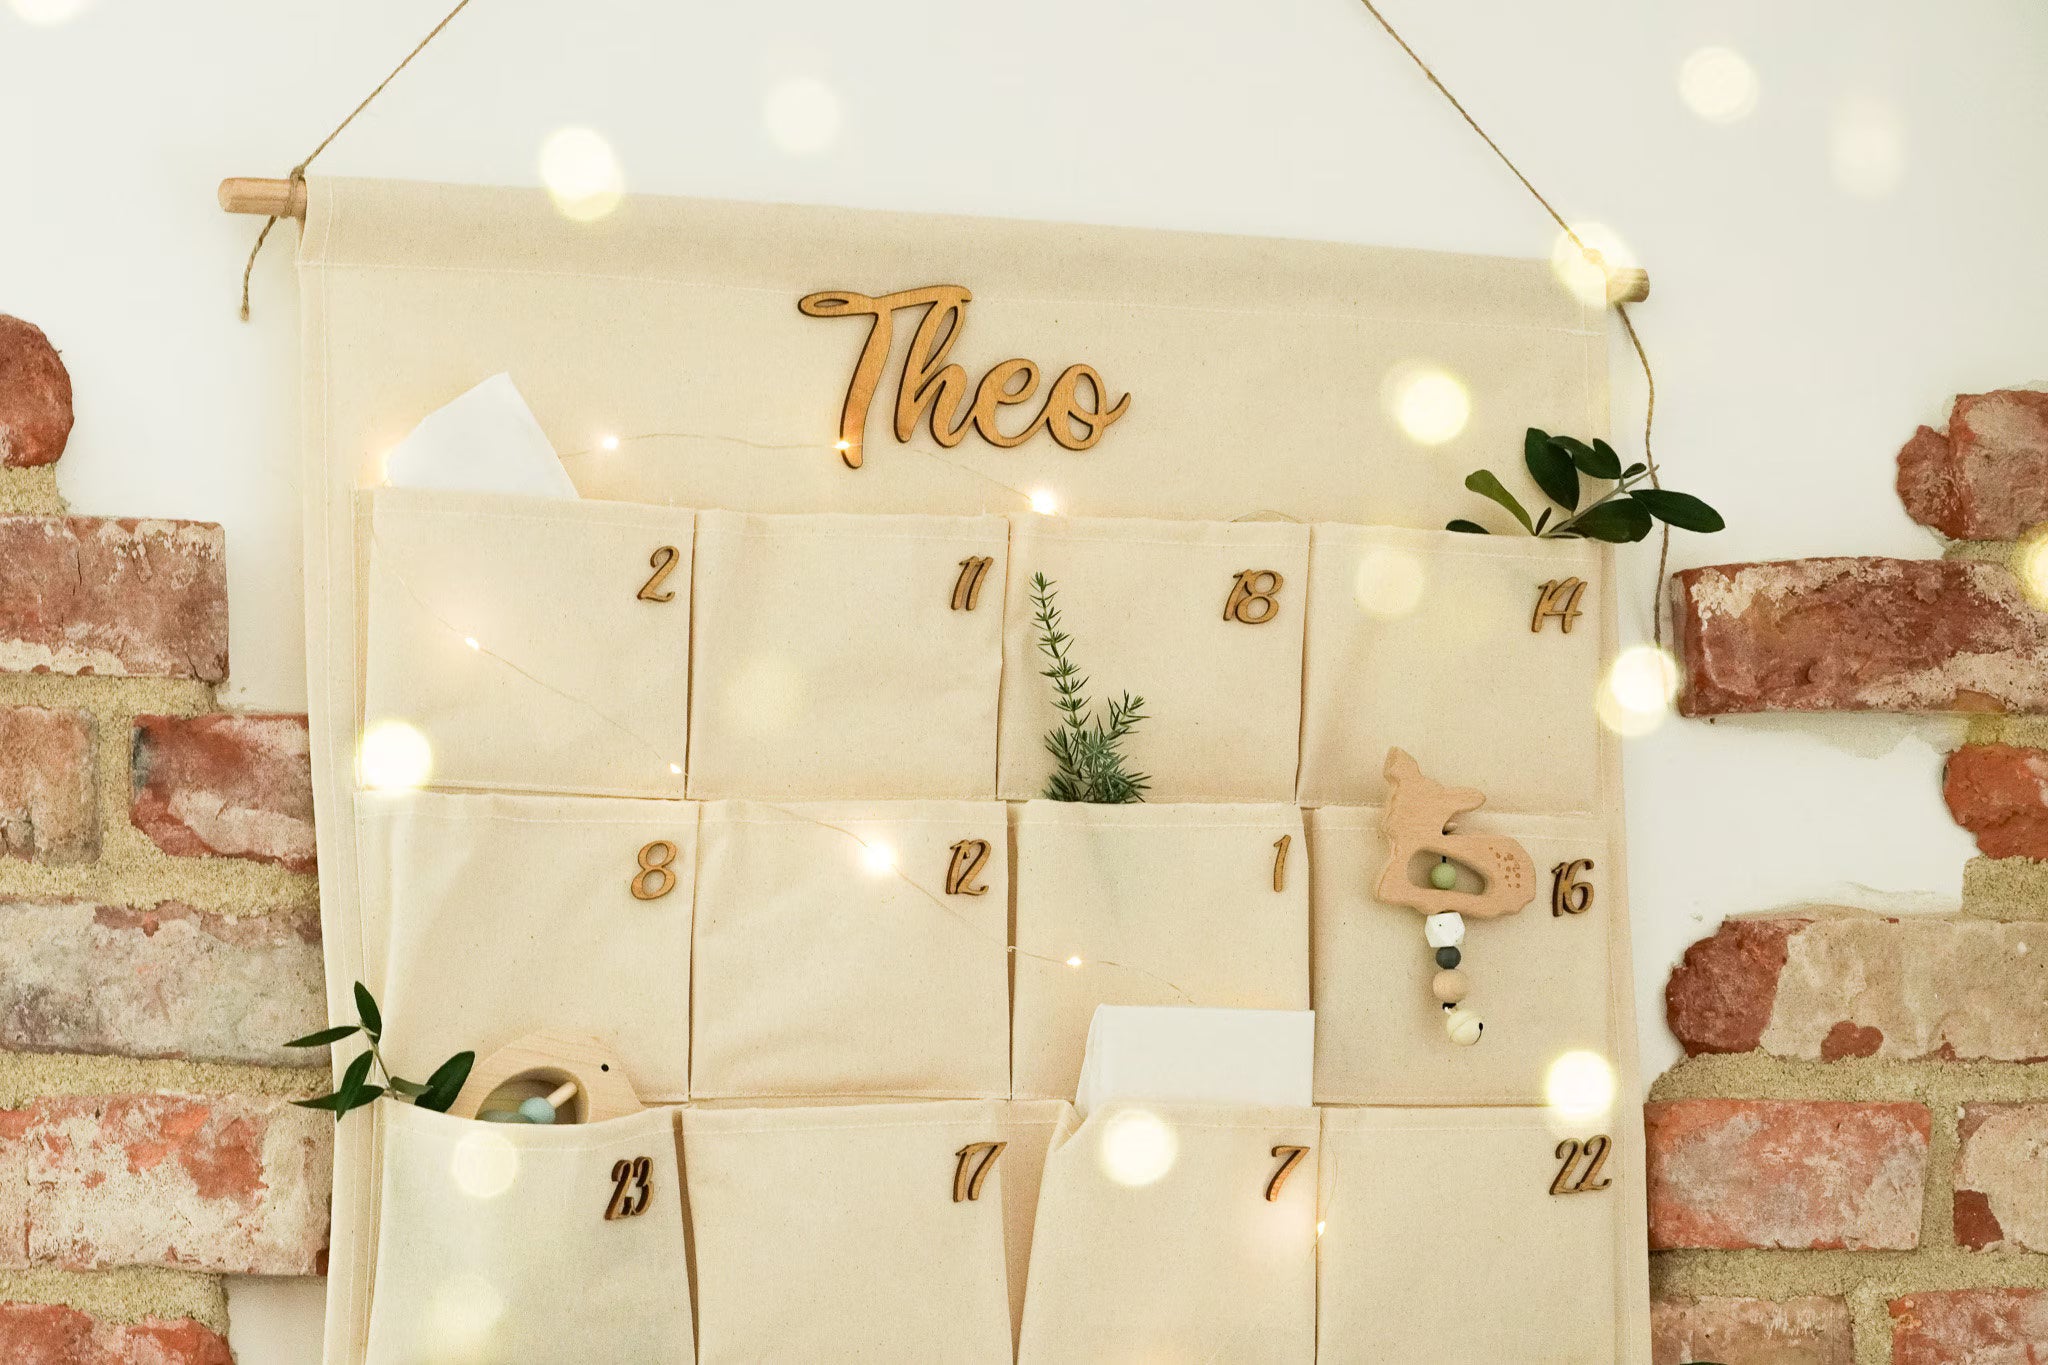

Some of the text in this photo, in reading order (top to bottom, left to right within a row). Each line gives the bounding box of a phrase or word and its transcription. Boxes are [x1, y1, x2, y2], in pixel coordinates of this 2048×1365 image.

[797, 284, 1131, 470] Theo
[636, 546, 679, 604] 2
[950, 556, 994, 612] 11
[1223, 569, 1284, 625] 18
[1531, 577, 1587, 634] 14
[631, 839, 677, 901] 8
[945, 838, 992, 896] 12
[1272, 834, 1292, 892] 1
[1551, 859, 1595, 917] 16
[605, 1156, 653, 1220] 23
[953, 1142, 1007, 1203] 17
[1264, 1144, 1311, 1202] 7
[1549, 1135, 1612, 1195] 22
